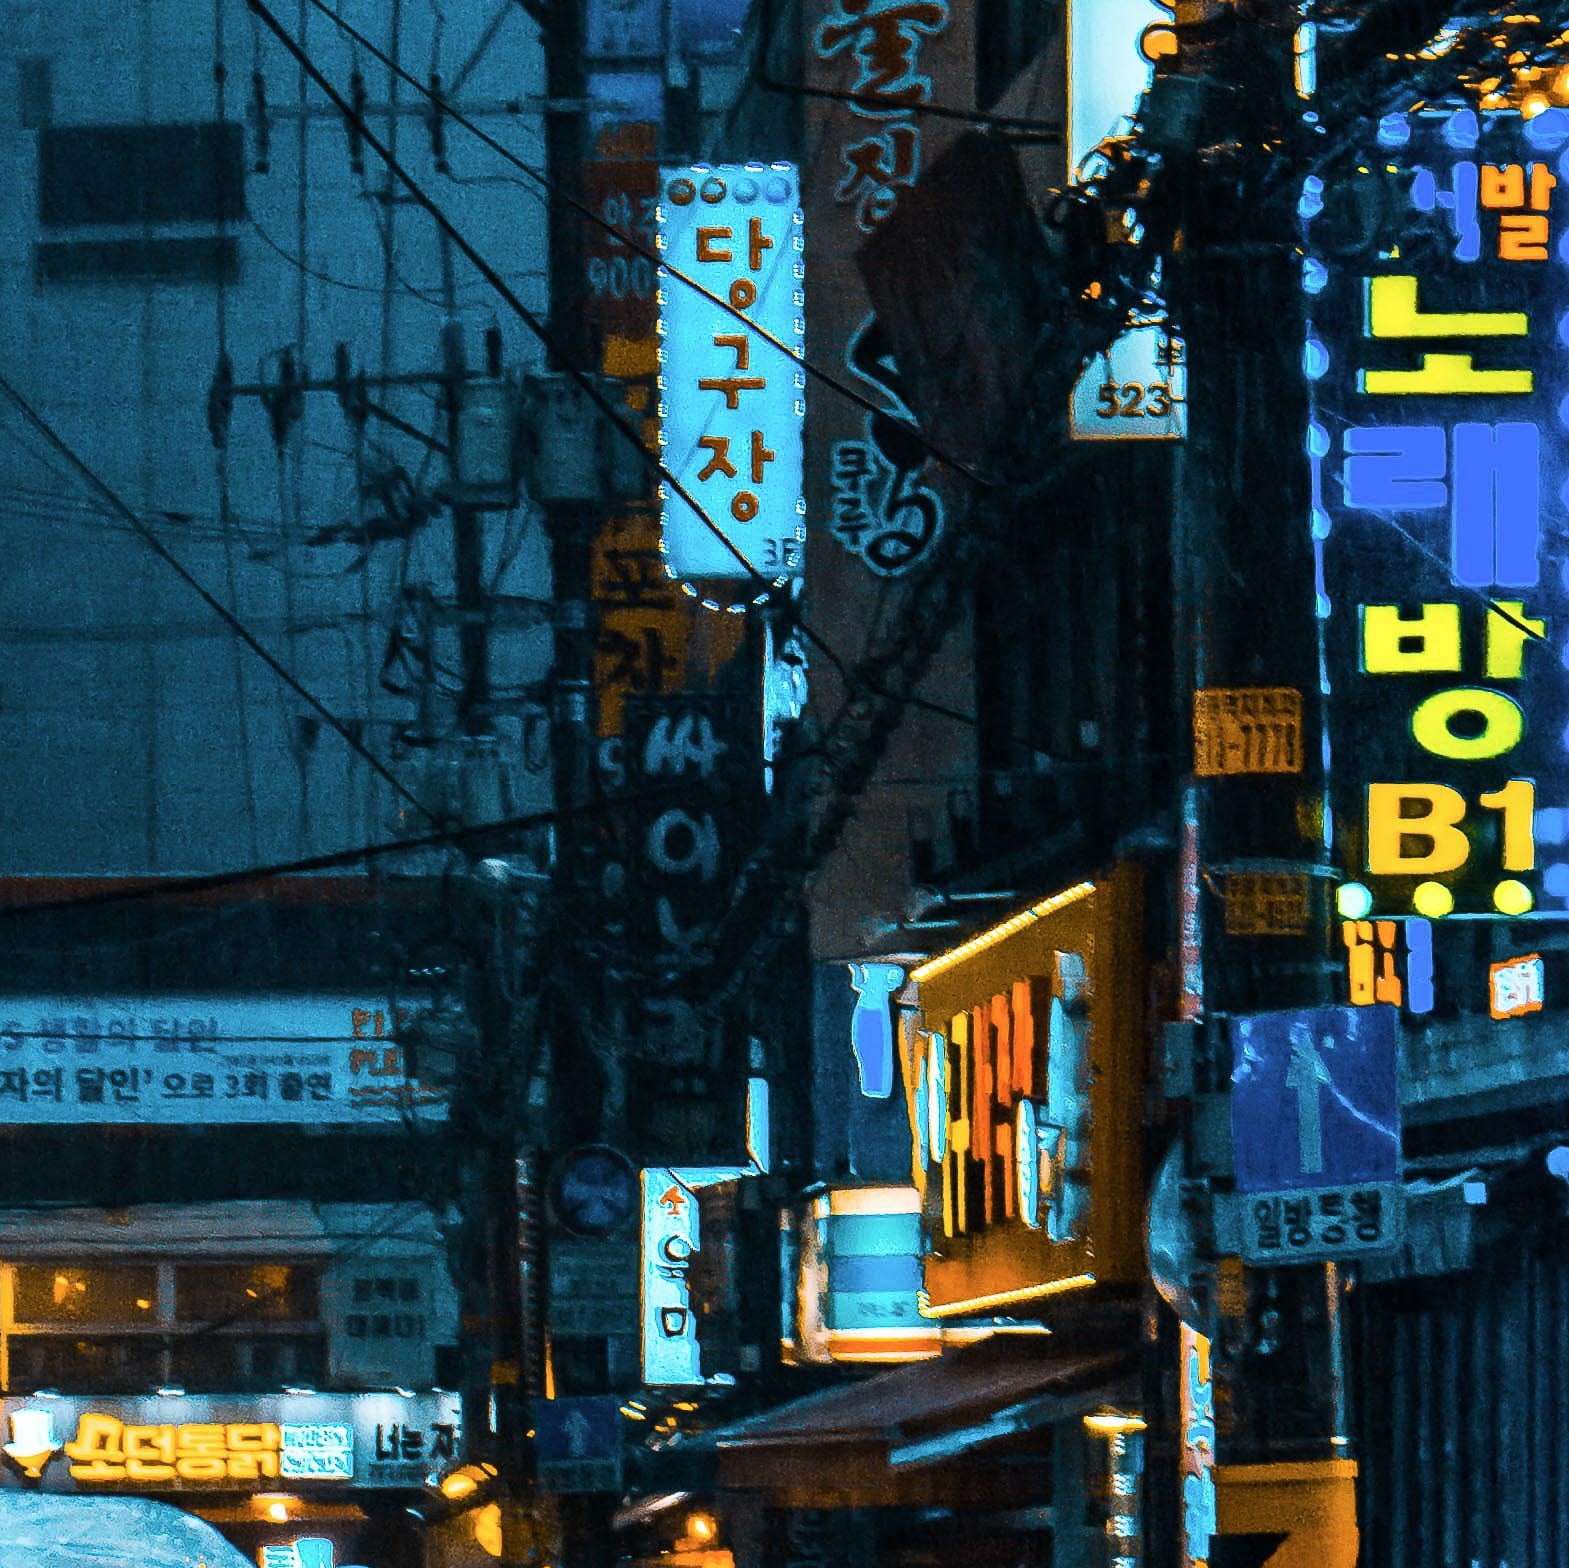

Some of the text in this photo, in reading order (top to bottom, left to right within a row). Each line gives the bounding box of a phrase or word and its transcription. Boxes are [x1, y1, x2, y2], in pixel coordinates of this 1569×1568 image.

[694, 215, 776, 522] 당구장
[1343, 275, 1549, 760] 노래방
[1368, 778, 1536, 876] B1
[152, 1016, 220, 1055] 달인
[160, 1072, 214, 1099] 으로
[1253, 1188, 1383, 1251] 일방통행
